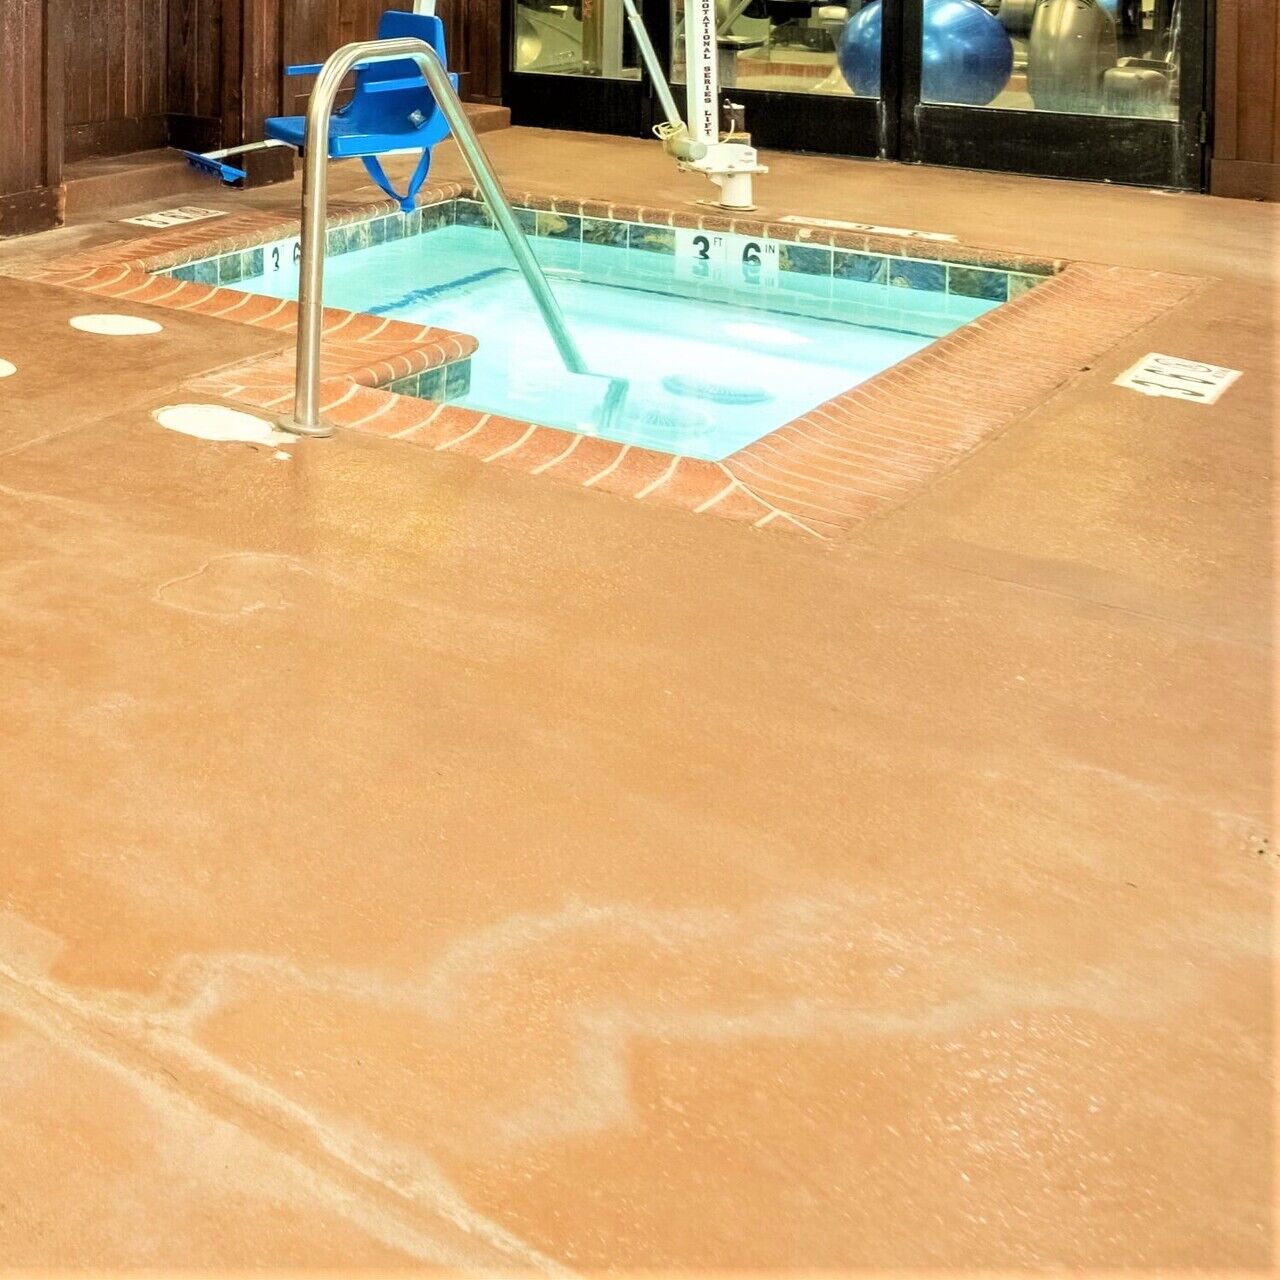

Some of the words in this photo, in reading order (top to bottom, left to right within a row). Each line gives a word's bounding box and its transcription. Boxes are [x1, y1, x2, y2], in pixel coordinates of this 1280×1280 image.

[703, 66, 711, 104] SERIES
[704, 110, 712, 137] LIFT
[692, 235, 710, 260] 3
[713, 237, 723, 248] FT
[742, 242, 761, 267] 6
[765, 244, 776, 255] IN
